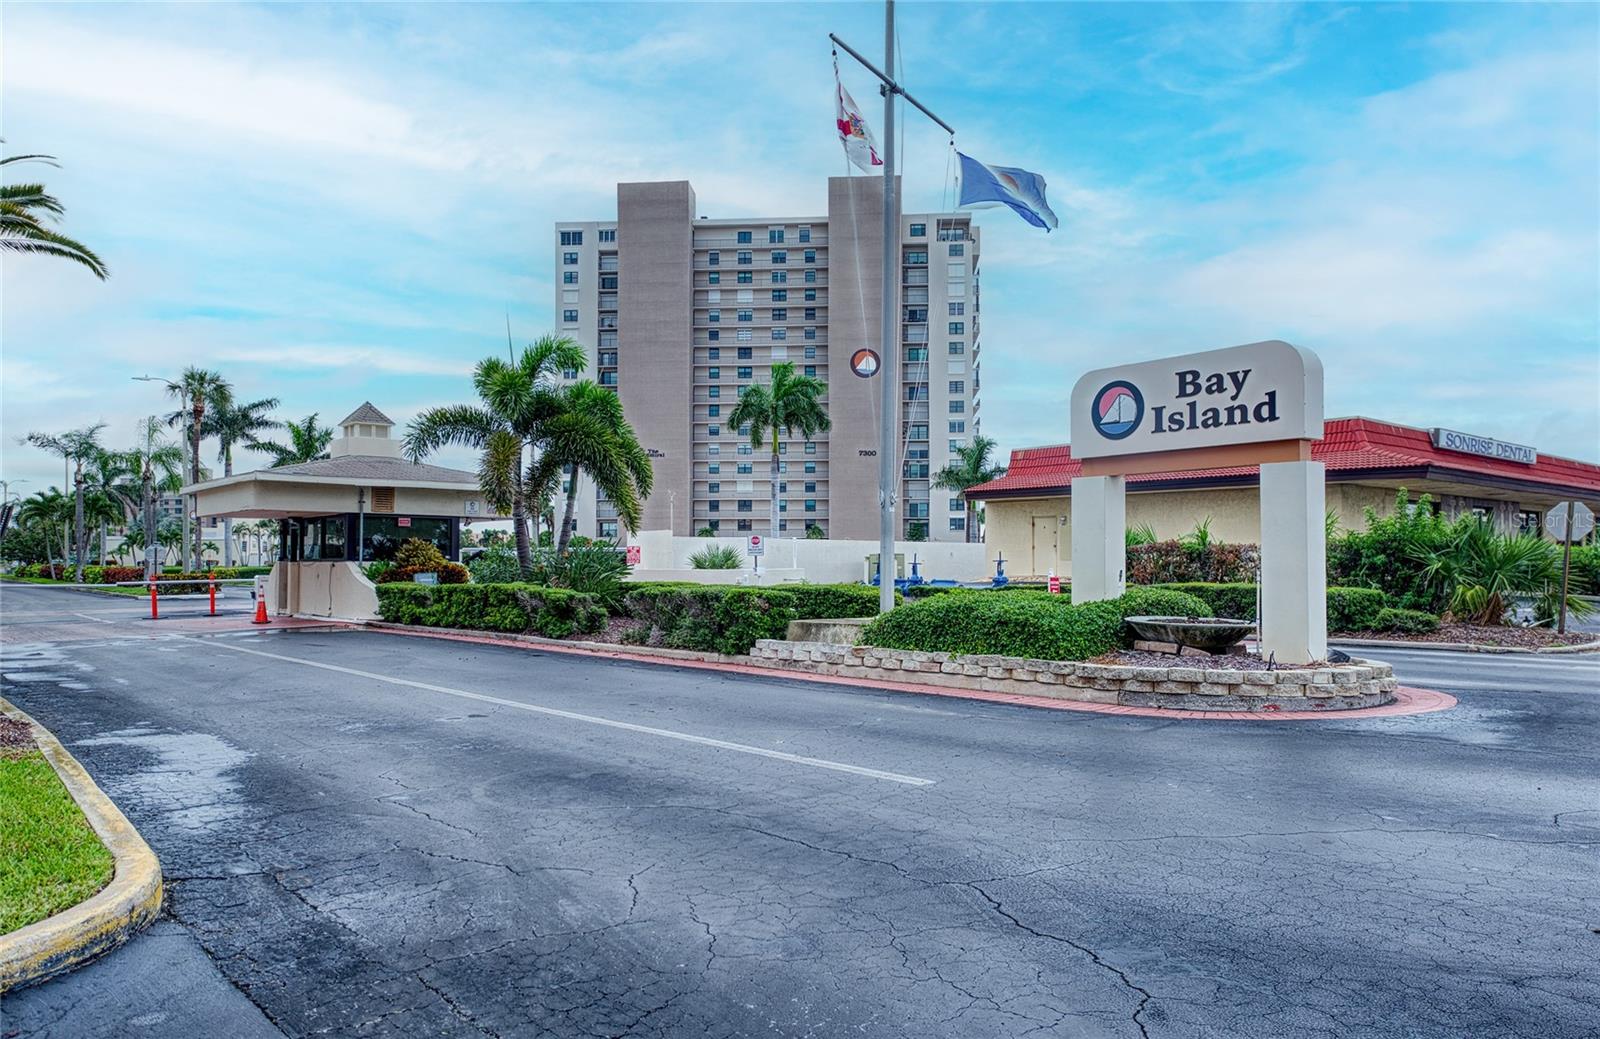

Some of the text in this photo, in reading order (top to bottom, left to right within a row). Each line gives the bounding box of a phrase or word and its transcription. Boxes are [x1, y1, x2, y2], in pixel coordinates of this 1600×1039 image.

[1175, 368, 1251, 401] Bay
[1151, 390, 1280, 434] Island
[1445, 432, 1534, 462] SONRISE DENTAL
